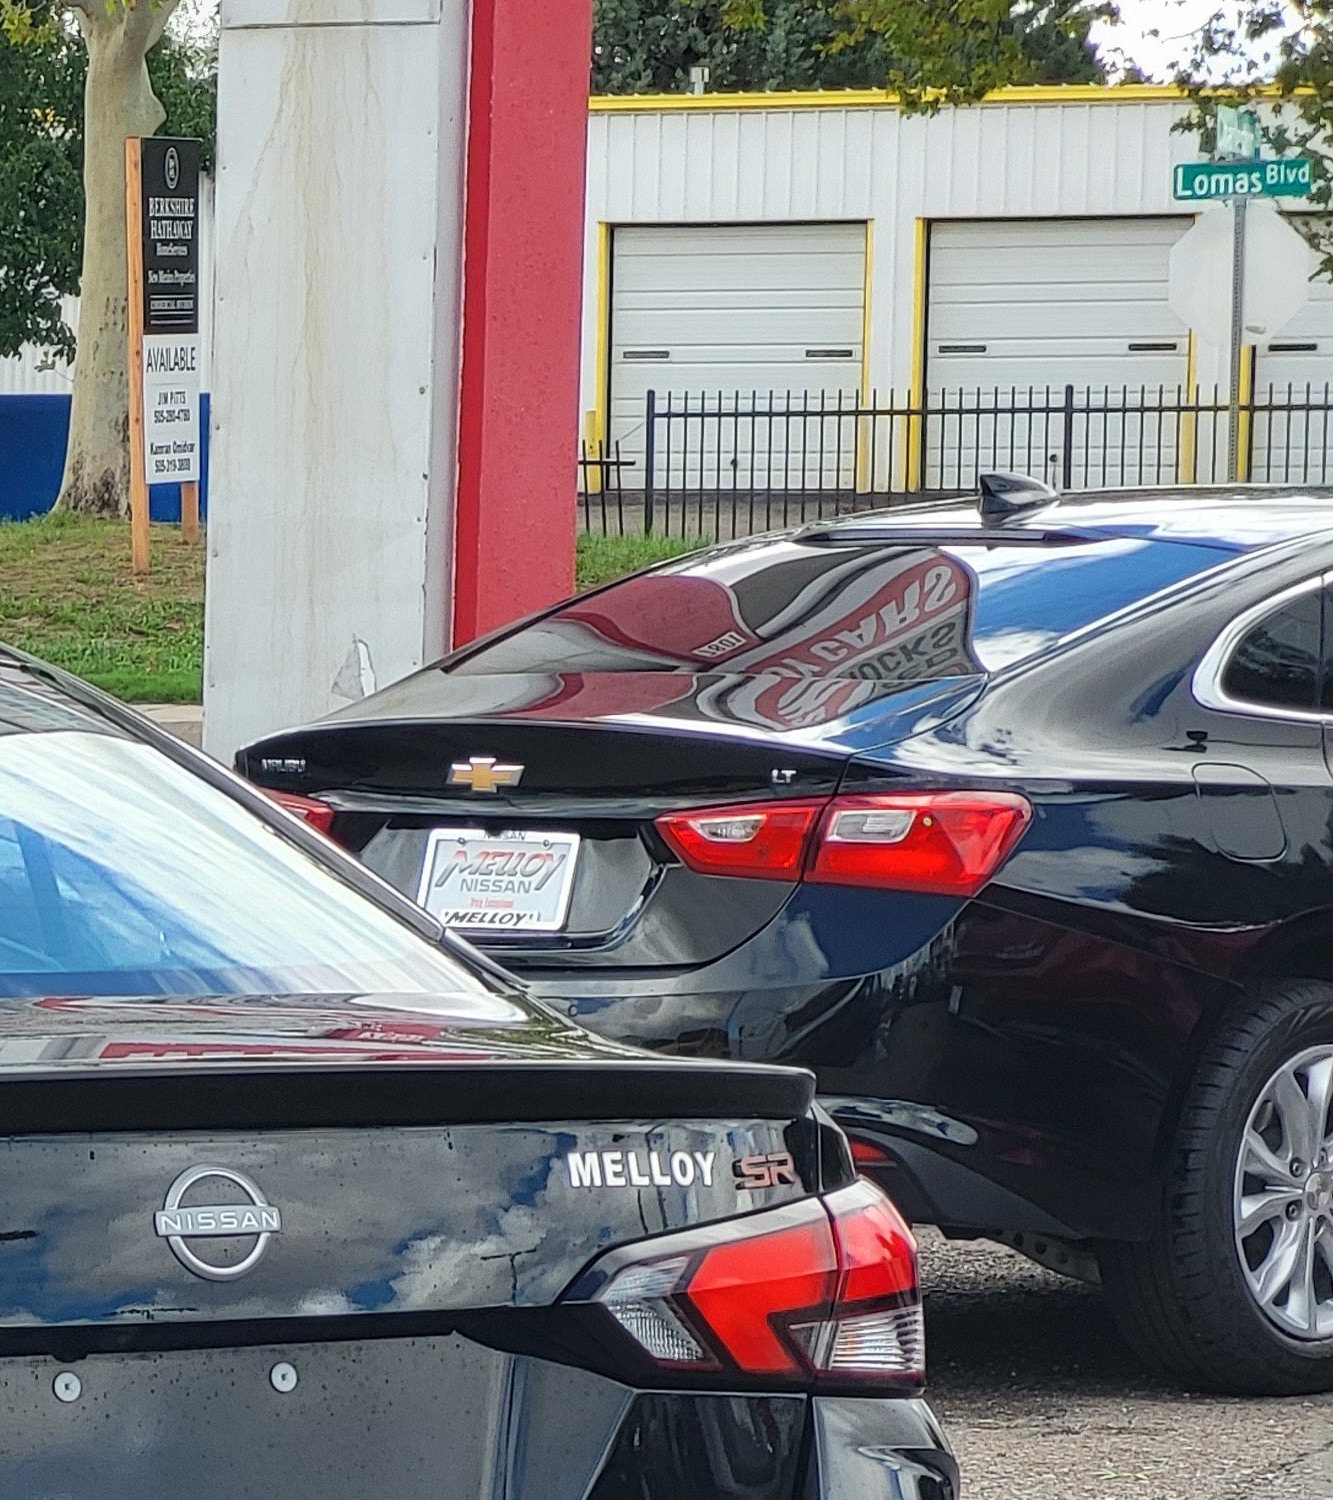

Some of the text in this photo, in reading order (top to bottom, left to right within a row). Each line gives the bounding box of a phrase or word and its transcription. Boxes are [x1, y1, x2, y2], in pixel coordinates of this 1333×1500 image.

[1177, 162, 1310, 196] Lomas Blvd
[149, 197, 195, 217] BERKSHIRE
[151, 220, 193, 239] HATHAWAY
[146, 347, 196, 372] AVAILABLE
[771, 769, 796, 784] LT
[460, 878, 532, 894] NISSAN
[568, 1151, 715, 1188] MELLOY
[734, 1152, 795, 1190] SR
[160, 1210, 278, 1231] NISSAN
